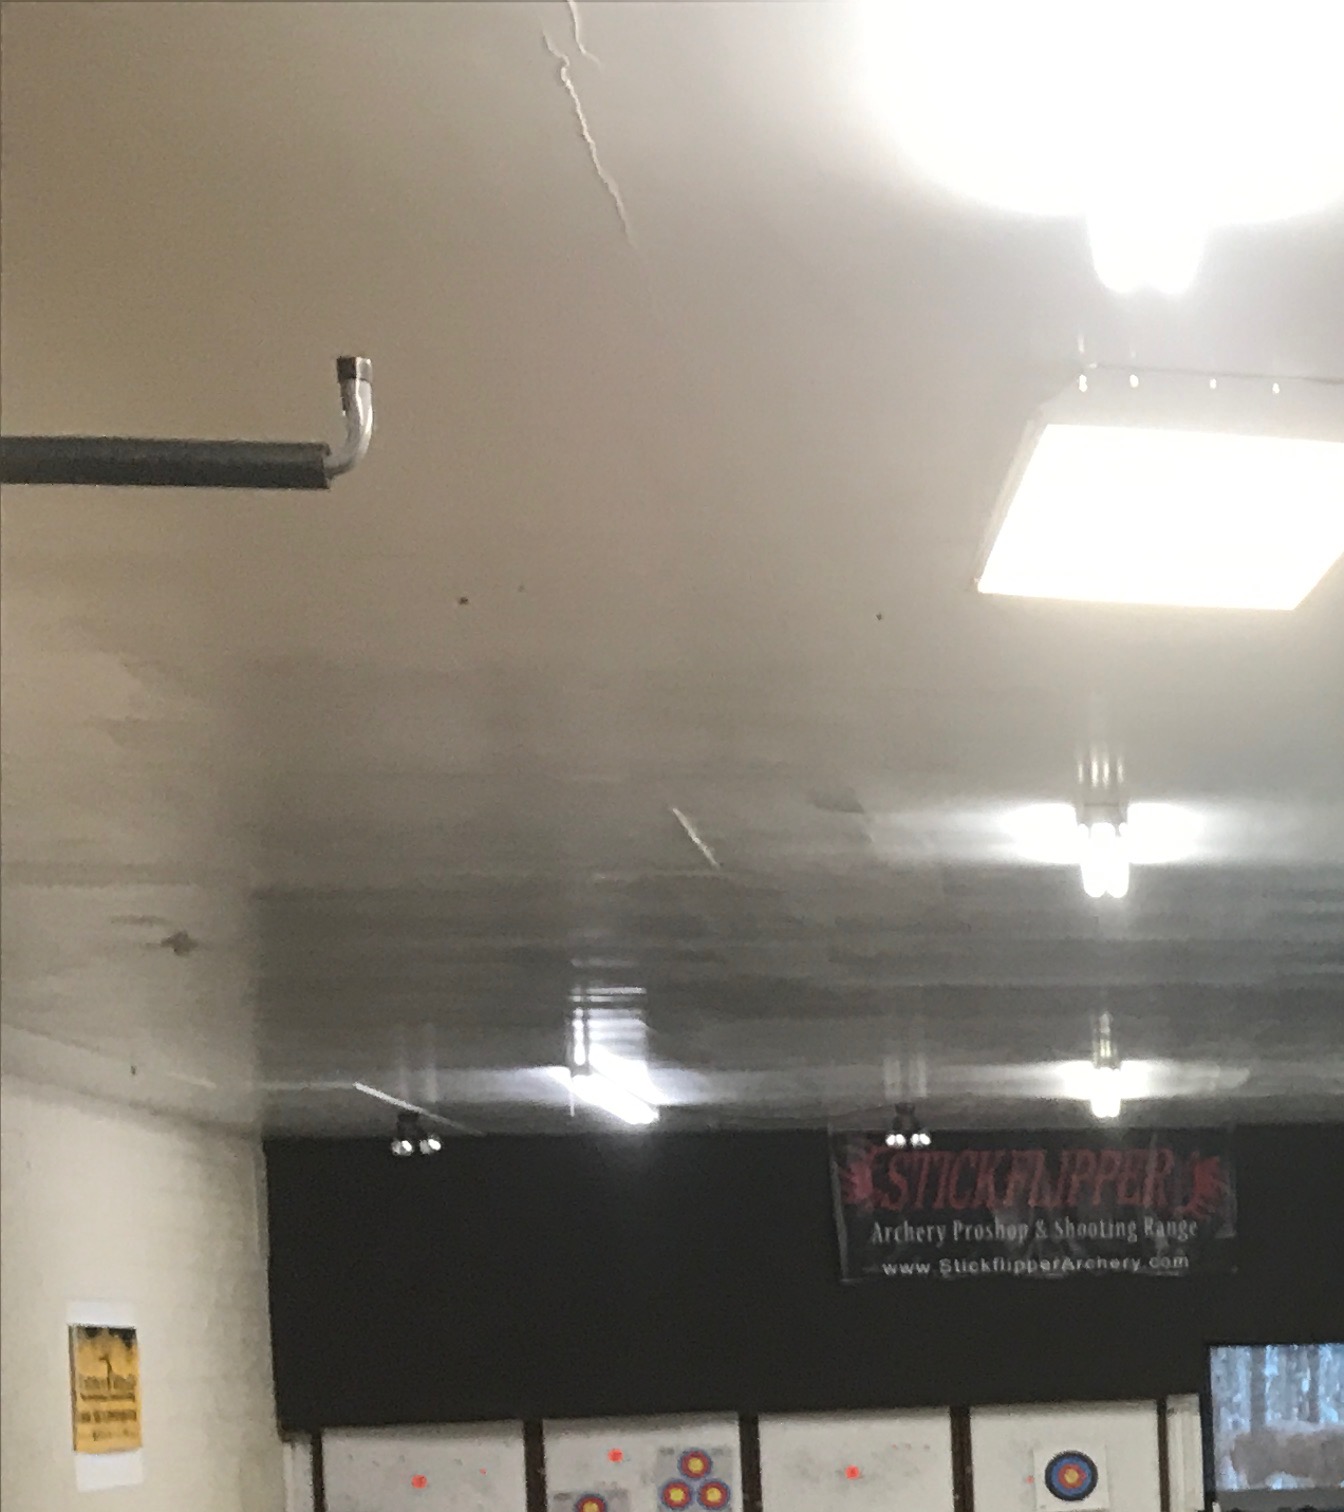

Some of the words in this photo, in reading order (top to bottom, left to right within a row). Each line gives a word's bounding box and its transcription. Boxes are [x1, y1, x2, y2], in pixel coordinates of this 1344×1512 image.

[871, 1220, 946, 1248] Archery
[952, 1218, 1029, 1245] Proshop
[1034, 1219, 1048, 1238] &
[1055, 1216, 1138, 1243] Shooting
[1143, 1216, 1199, 1242] Range
